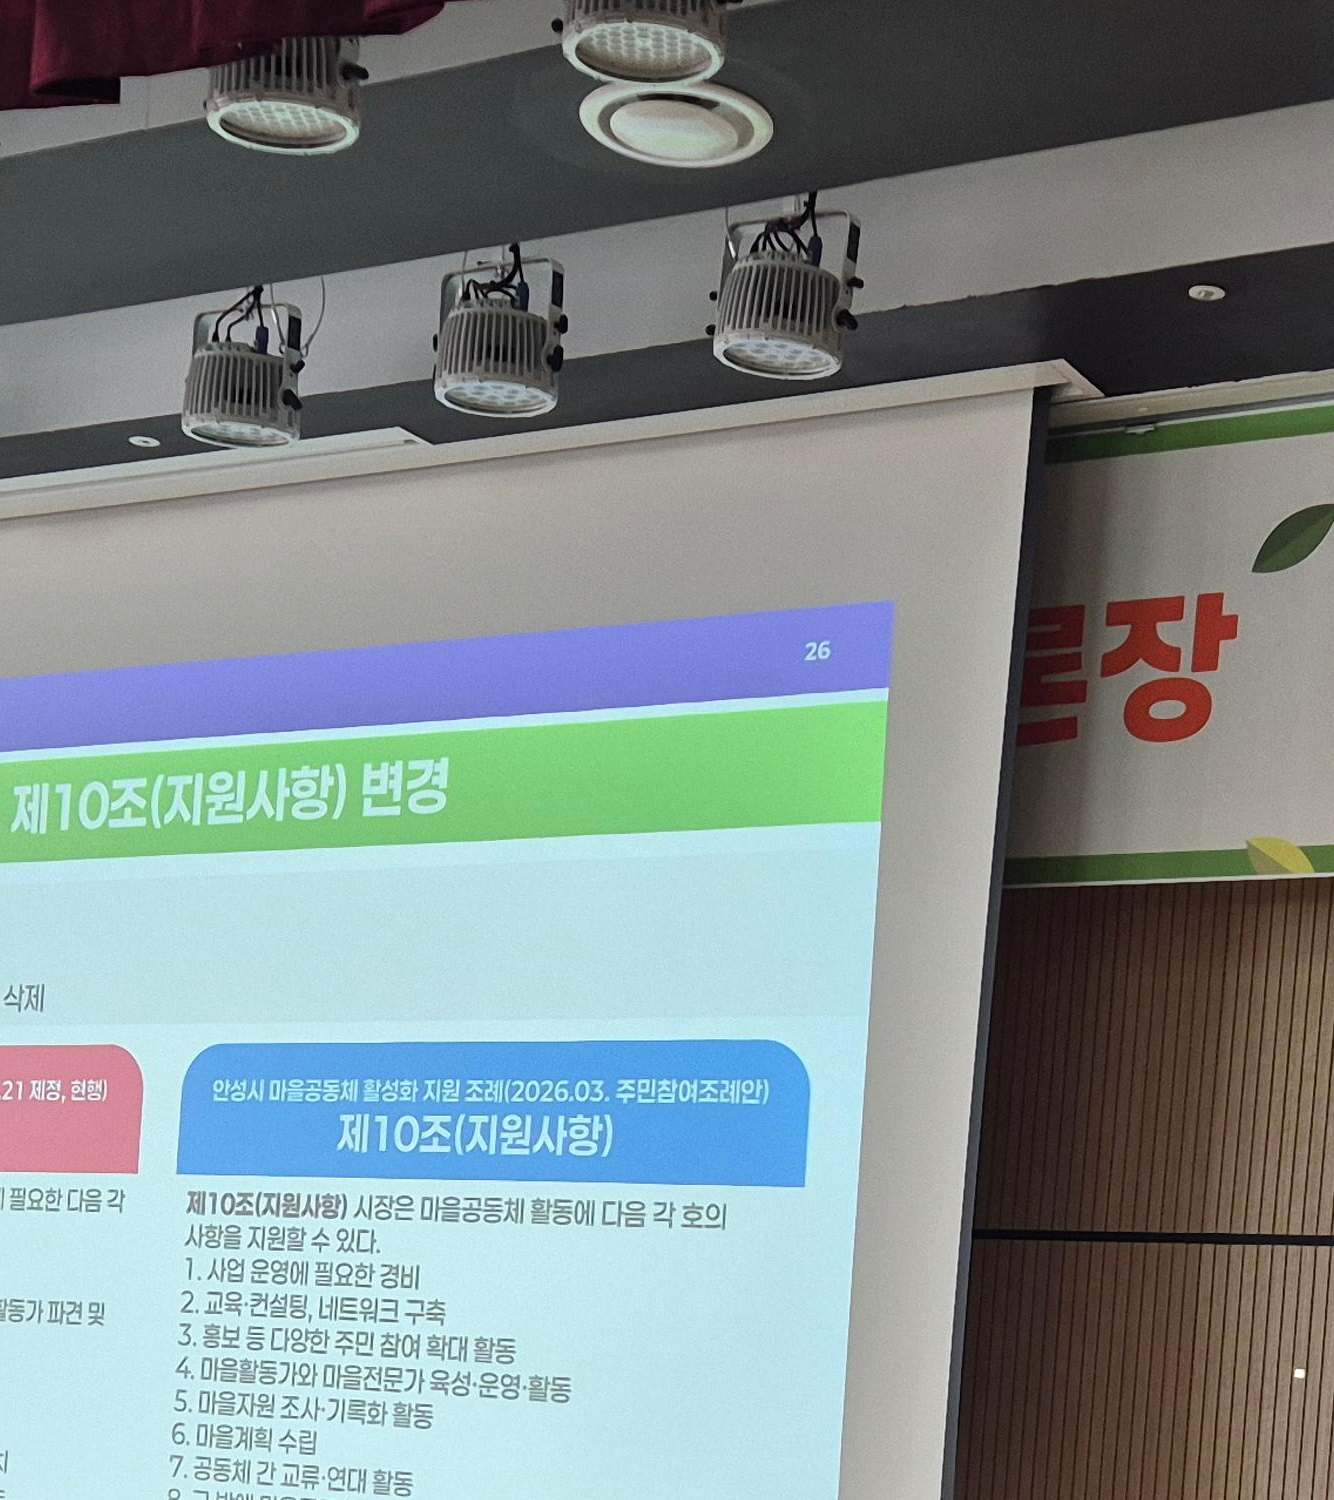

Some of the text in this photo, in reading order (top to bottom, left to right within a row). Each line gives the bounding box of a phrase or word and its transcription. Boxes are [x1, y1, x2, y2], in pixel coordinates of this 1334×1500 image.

[804, 640, 830, 661] 26
[10, 756, 449, 835] 제10조(지원사항) 변경
[3, 983, 44, 1013] 삭제
[28, 1080, 65, 1103] 제정,
[70, 1079, 107, 1101] 현행)
[212, 1078, 769, 1104] 안성시 마을공동체 활성화 지원 조례(2026.03. 주민참여조례안)
[336, 1113, 612, 1157] 제10조(지원사항)
[9, 1187, 63, 1212] 필요한
[66, 1188, 102, 1213] 다음
[106, 1189, 125, 1214] 각
[185, 1191, 726, 1230] 제10조(지원사항) 시장은 마을공동체 활동에 다음 각 호의
[184, 1224, 380, 1254] 사항을 지원할 수 있다.
[185, 1257, 420, 1290] 1. 사업 운영에 필요한 경비
[46, 1300, 82, 1326] 파견
[87, 1302, 104, 1326] 및
[180, 1290, 198, 1314] 2.
[318, 1295, 399, 1324] 네트워크
[404, 1298, 445, 1326] 구축
[177, 1323, 516, 1365] 3. 홍보 등 다양한 주민 참여 확대 활동
[175, 1356, 194, 1380] 4.
[200, 1357, 318, 1392] 마을활동가와
[322, 1364, 425, 1394] 마을전문가
[173, 1389, 192, 1413] 5.
[198, 1390, 275, 1419] 마을자원
[392, 1402, 433, 1430] 활동
[171, 1422, 317, 1456] 6. 마을계획 수립
[169, 1455, 187, 1479] 7.
[193, 1456, 251, 1484] 공동체
[256, 1461, 276, 1486] 간
[372, 1469, 413, 1498] 활동
